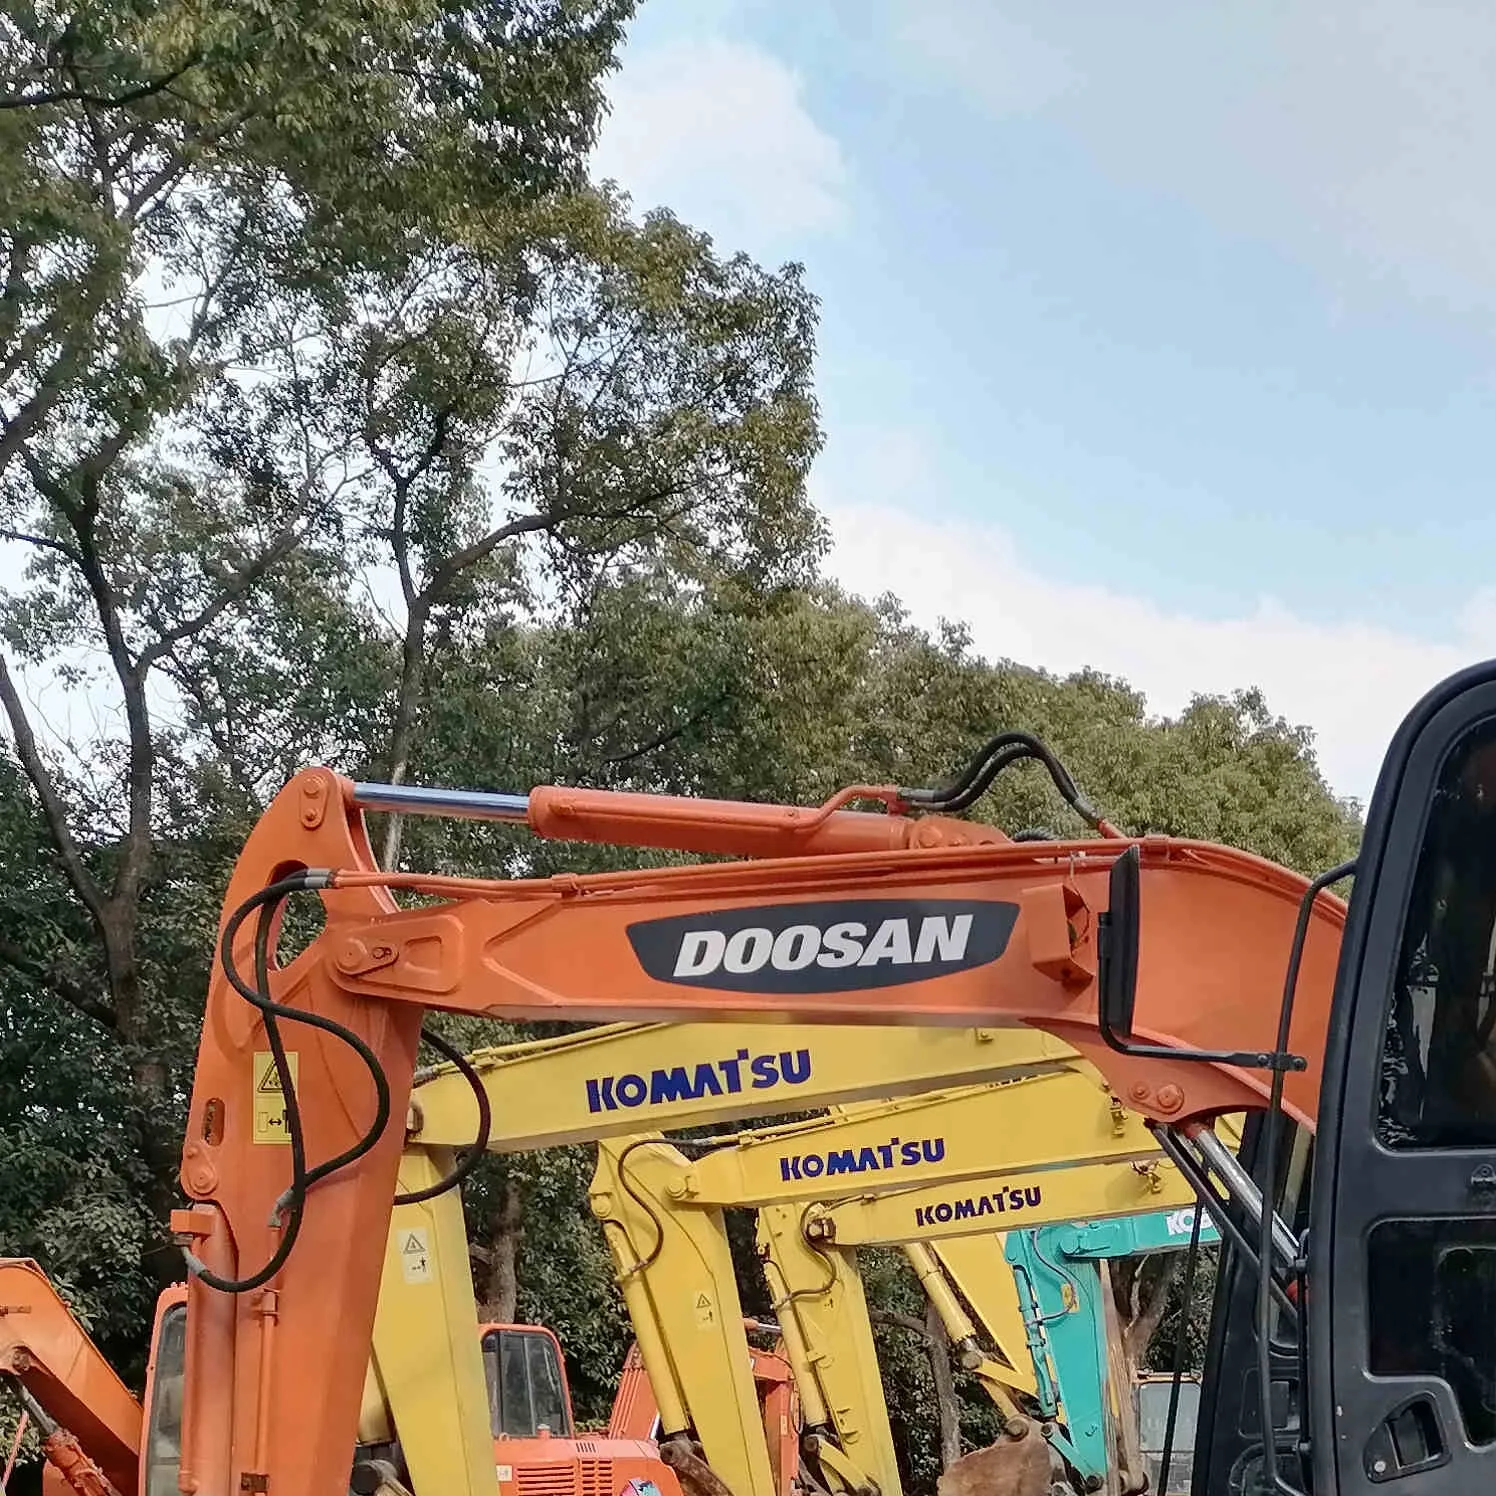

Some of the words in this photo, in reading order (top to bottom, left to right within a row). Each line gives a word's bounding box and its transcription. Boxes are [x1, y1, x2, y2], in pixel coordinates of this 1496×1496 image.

[673, 914, 974, 977] DOOSAN
[586, 1048, 811, 1113] KOMATSU
[780, 1137, 945, 1181] KOMATSU
[915, 1186, 1041, 1226] KOMATSU
